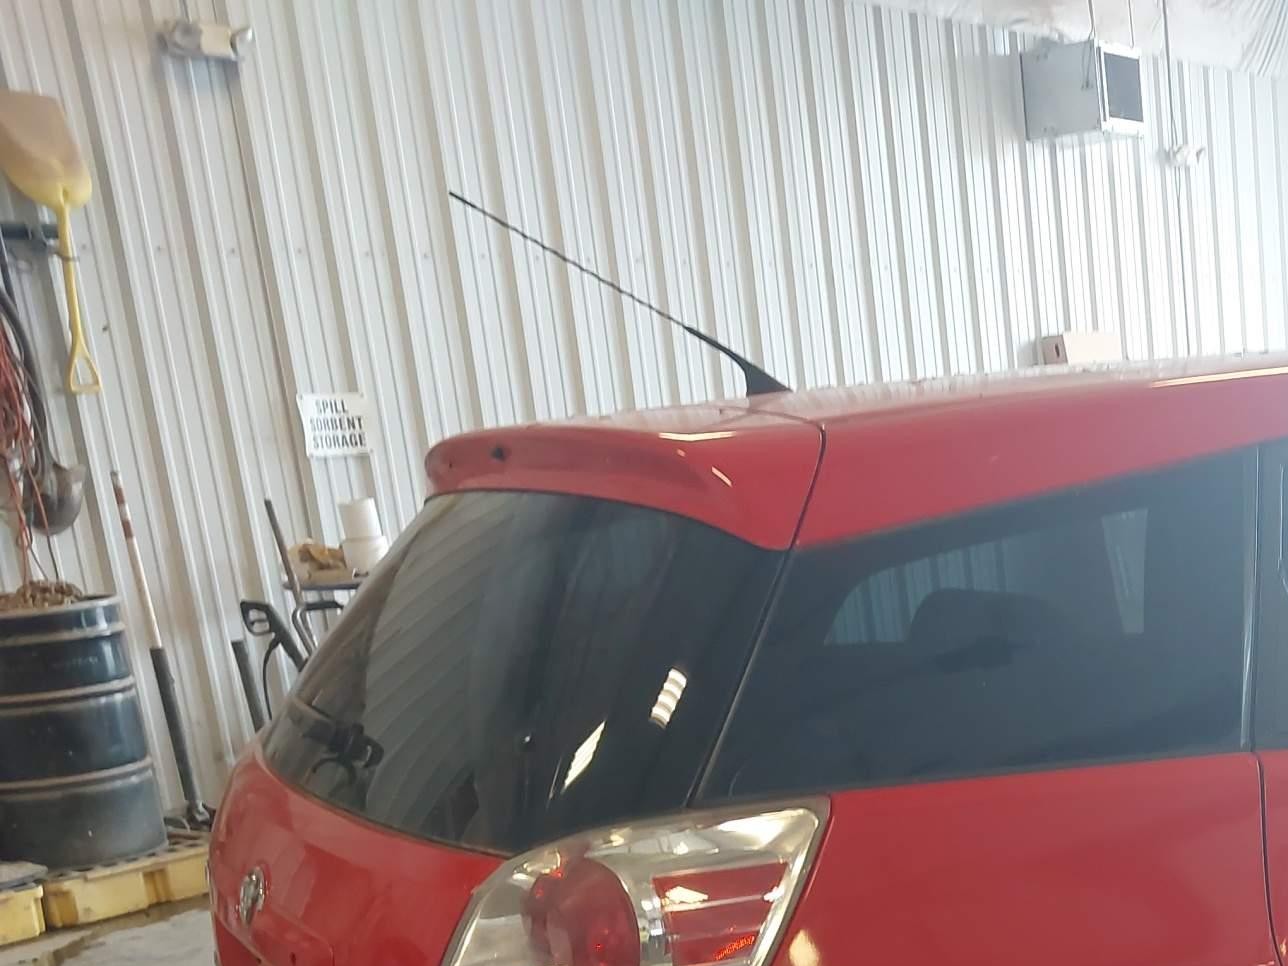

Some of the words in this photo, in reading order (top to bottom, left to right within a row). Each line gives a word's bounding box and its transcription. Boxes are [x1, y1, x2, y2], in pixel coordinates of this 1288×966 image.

[315, 399, 349, 414] SPILL
[310, 415, 363, 432] SORBENT
[313, 432, 367, 449] STORAGE
